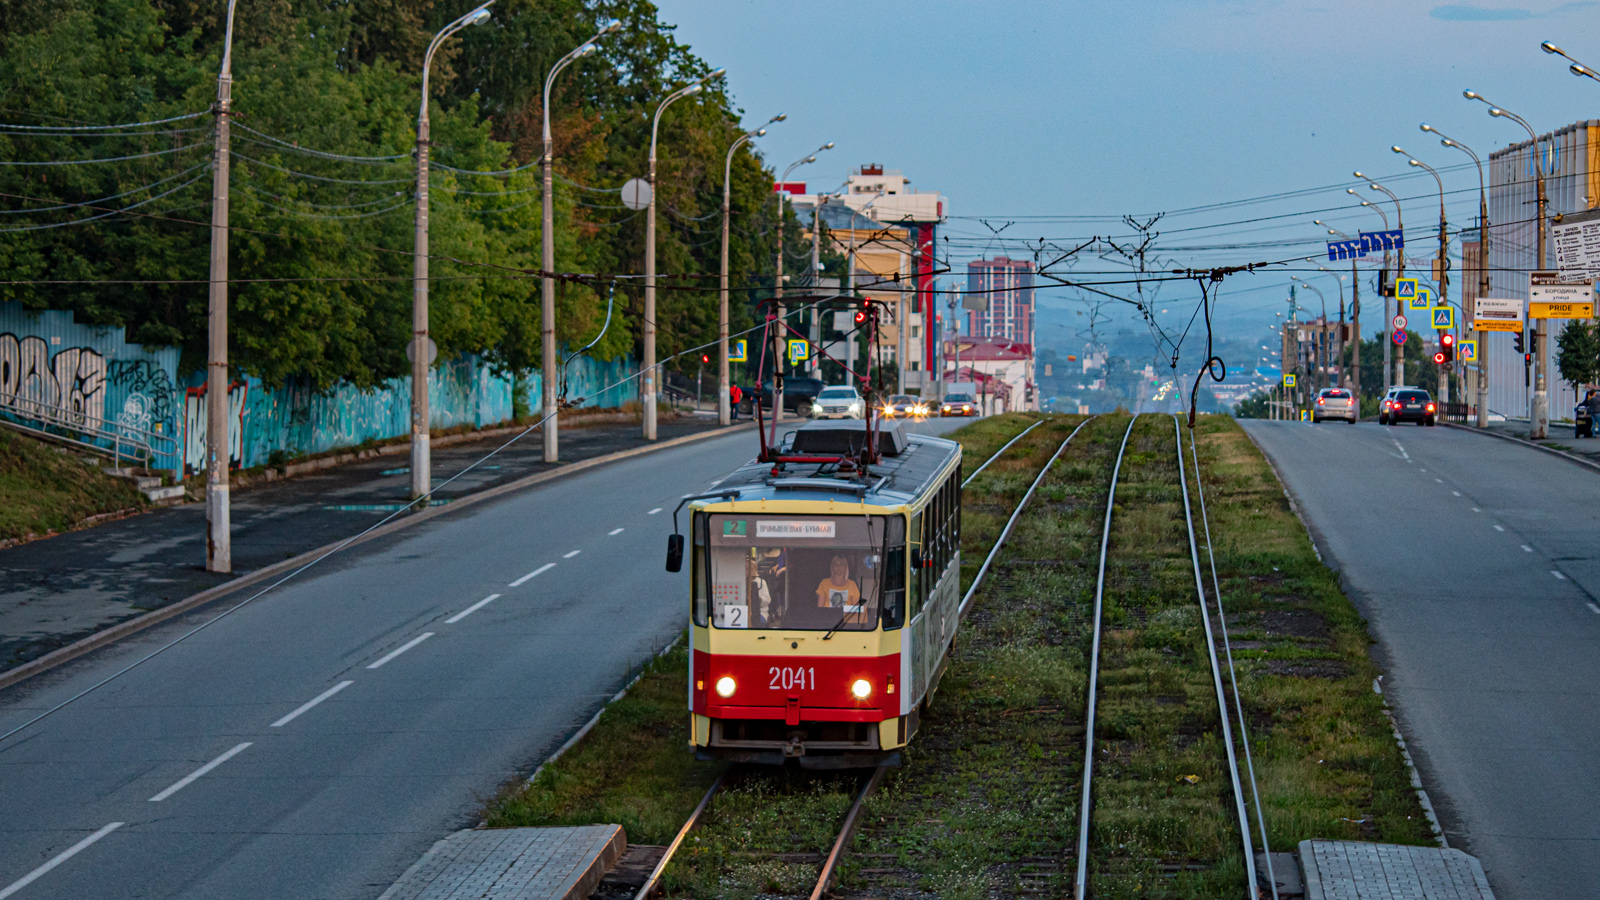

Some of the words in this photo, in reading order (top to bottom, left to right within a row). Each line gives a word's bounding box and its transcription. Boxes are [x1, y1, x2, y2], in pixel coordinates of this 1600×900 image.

[730, 520, 738, 533] 2
[731, 607, 742, 627] 2
[769, 666, 815, 690] 2041
